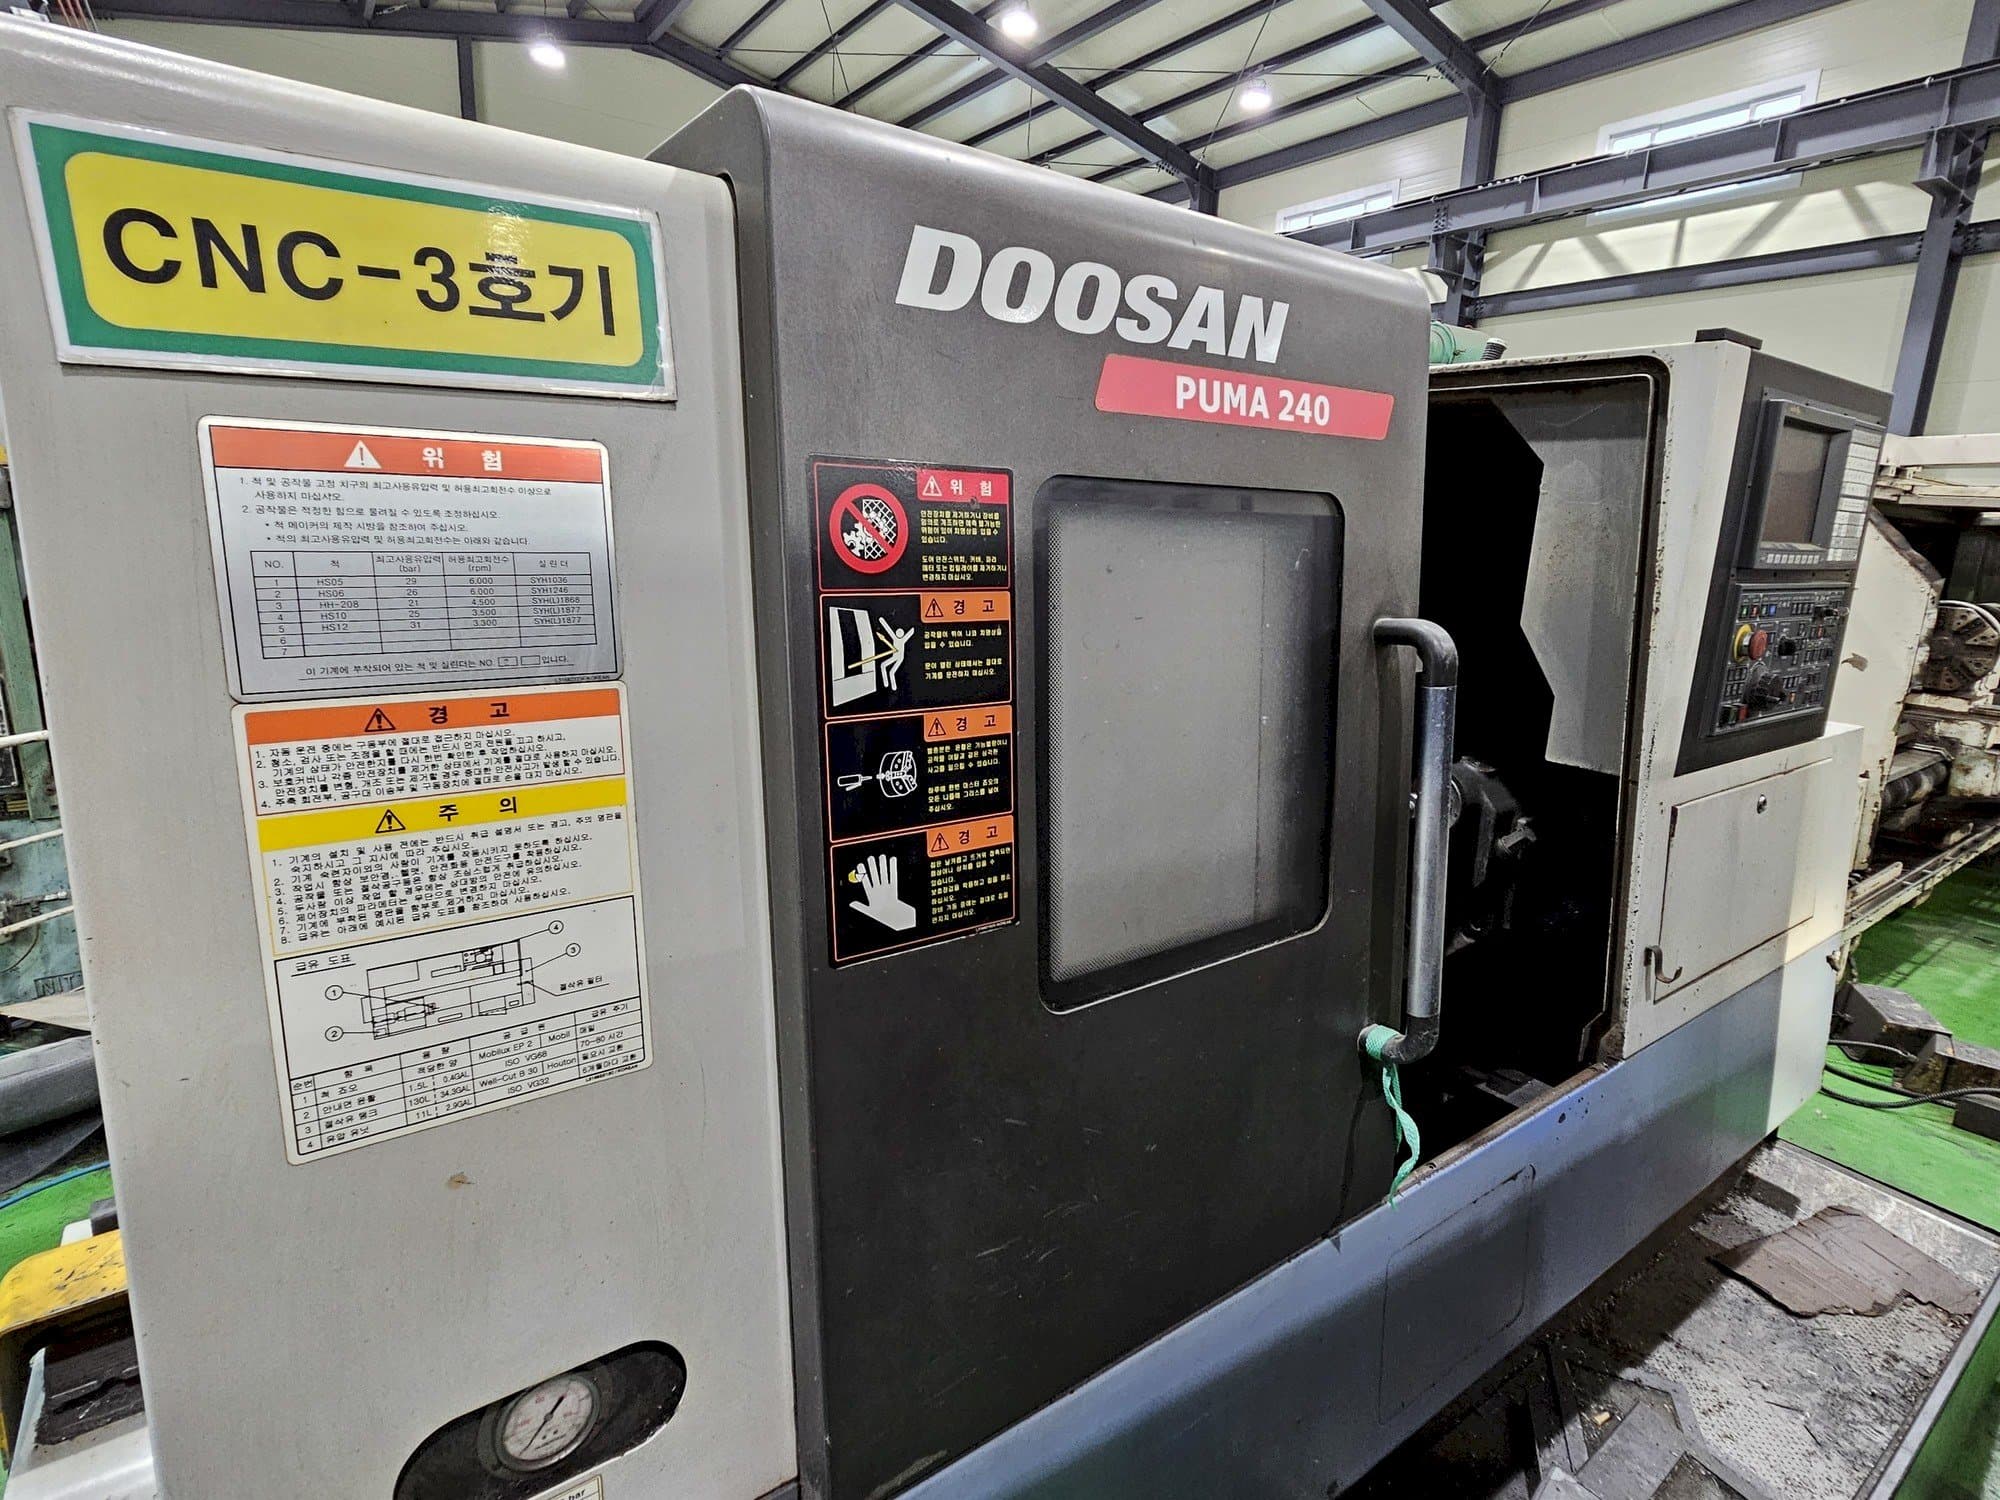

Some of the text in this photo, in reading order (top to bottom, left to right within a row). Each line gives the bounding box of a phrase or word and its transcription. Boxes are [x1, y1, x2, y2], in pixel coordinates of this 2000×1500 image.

[102, 208, 616, 336] CNC-3호기
[895, 224, 1290, 364] DOOSAN
[1175, 374, 1330, 426] PUMA 240
[422, 447, 502, 472] 위 험
[251, 477, 262, 486] 척
[280, 476, 311, 488] 공작물
[315, 479, 336, 488] 고정
[339, 479, 368, 489] 치구의
[372, 481, 438, 492] 최고사용유압력
[454, 484, 515, 494] 허용최고회전수
[518, 486, 551, 496] 이상으로
[951, 480, 991, 496] 위 험
[254, 490, 296, 500] 사용하지
[241, 504, 250, 513] 2.
[255, 504, 297, 515] 공작물은
[300, 506, 331, 516] 적정한
[335, 506, 364, 516] 힘으로
[412, 508, 441, 518] 있도록
[444, 509, 500, 519] 조정하십시오.
[274, 520, 284, 529] 척
[288, 520, 328, 530] 메이커의
[332, 521, 352, 530] 제작
[356, 521, 385, 531] 시방을
[275, 534, 296, 543] 척의
[300, 534, 370, 544] 최고사용유압력
[386, 535, 460, 545] 허용최고회전수는
[463, 536, 490, 545] 아래와
[264, 560, 284, 568] NO.
[330, 560, 340, 568] 척
[376, 555, 441, 564] 최고사용유압력
[400, 564, 491, 573] (bar) (rpm)
[276, 602, 282, 610] 3
[954, 600, 994, 615] 경 고
[321, 612, 347, 620] HS10
[305, 666, 315, 677] 이
[319, 665, 349, 675] 기계에
[394, 662, 413, 672] 있는
[418, 662, 426, 670] 척
[440, 659, 475, 669] 실린더는
[429, 702, 509, 724] 경 고
[957, 715, 996, 731] 경 고
[439, 796, 517, 822] 주 의
[960, 826, 998, 845] 경 고
[548, 1031, 570, 1041] Mobil
[479, 1048, 511, 1059] Mobilux
[513, 1042, 524, 1051] EP
[505, 1051, 548, 1067] ISO VG68
[480, 1073, 517, 1087] Well-Cut
[528, 1067, 538, 1075] 30
[409, 1082, 428, 1092] 1.5L
[507, 1077, 550, 1094] ISO VG32
[409, 1096, 430, 1106] 130L
[416, 1110, 432, 1119] 11L
